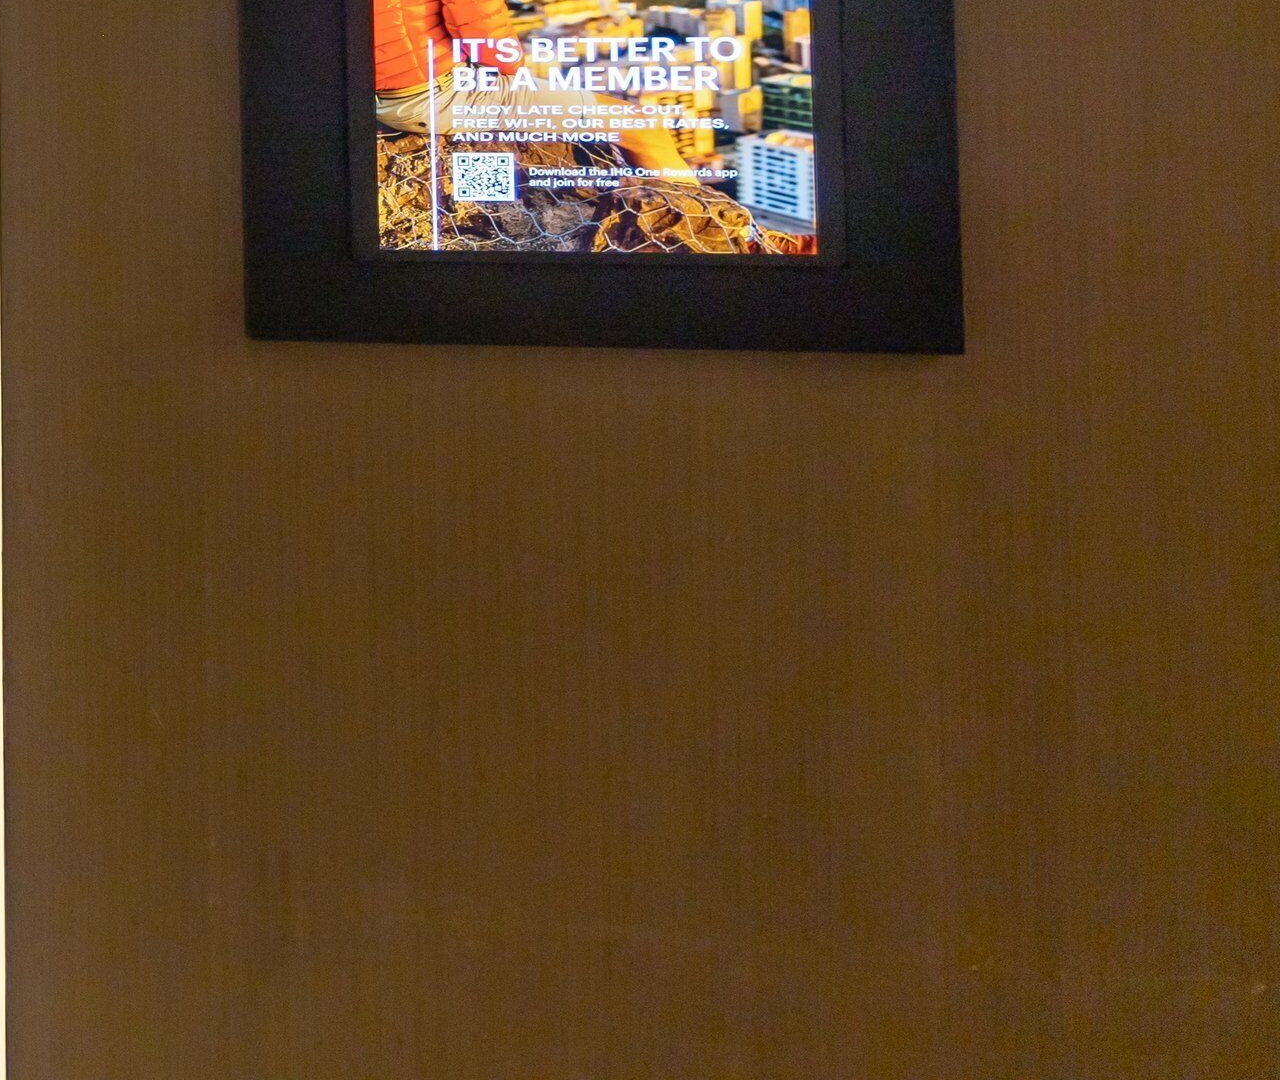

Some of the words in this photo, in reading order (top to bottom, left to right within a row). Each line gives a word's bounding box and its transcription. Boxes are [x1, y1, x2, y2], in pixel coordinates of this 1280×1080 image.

[452, 37, 520, 63] IT'S
[531, 36, 677, 62] BETTER
[685, 36, 742, 62] TO
[452, 66, 500, 91] BE
[510, 66, 538, 91] A
[548, 66, 720, 91] MEMBER
[452, 105, 512, 115] ENJOY
[517, 105, 563, 115] LATE
[452, 118, 500, 129] FREE
[504, 118, 557, 130] WI-FI,
[561, 118, 604, 129] OUR
[609, 118, 658, 129] BEST
[662, 118, 730, 130] RATES,
[452, 132, 493, 142] AND
[499, 132, 557, 142] MUCH
[562, 132, 620, 142] MORE
[529, 167, 588, 177] Download
[589, 167, 607, 177] the
[611, 167, 633, 177] IHG
[635, 167, 660, 177] One
[663, 167, 712, 177] Rewards
[715, 169, 738, 179] app
[529, 177, 551, 187] and
[553, 178, 575, 188] join
[577, 177, 594, 187] for
[596, 177, 620, 187] free
